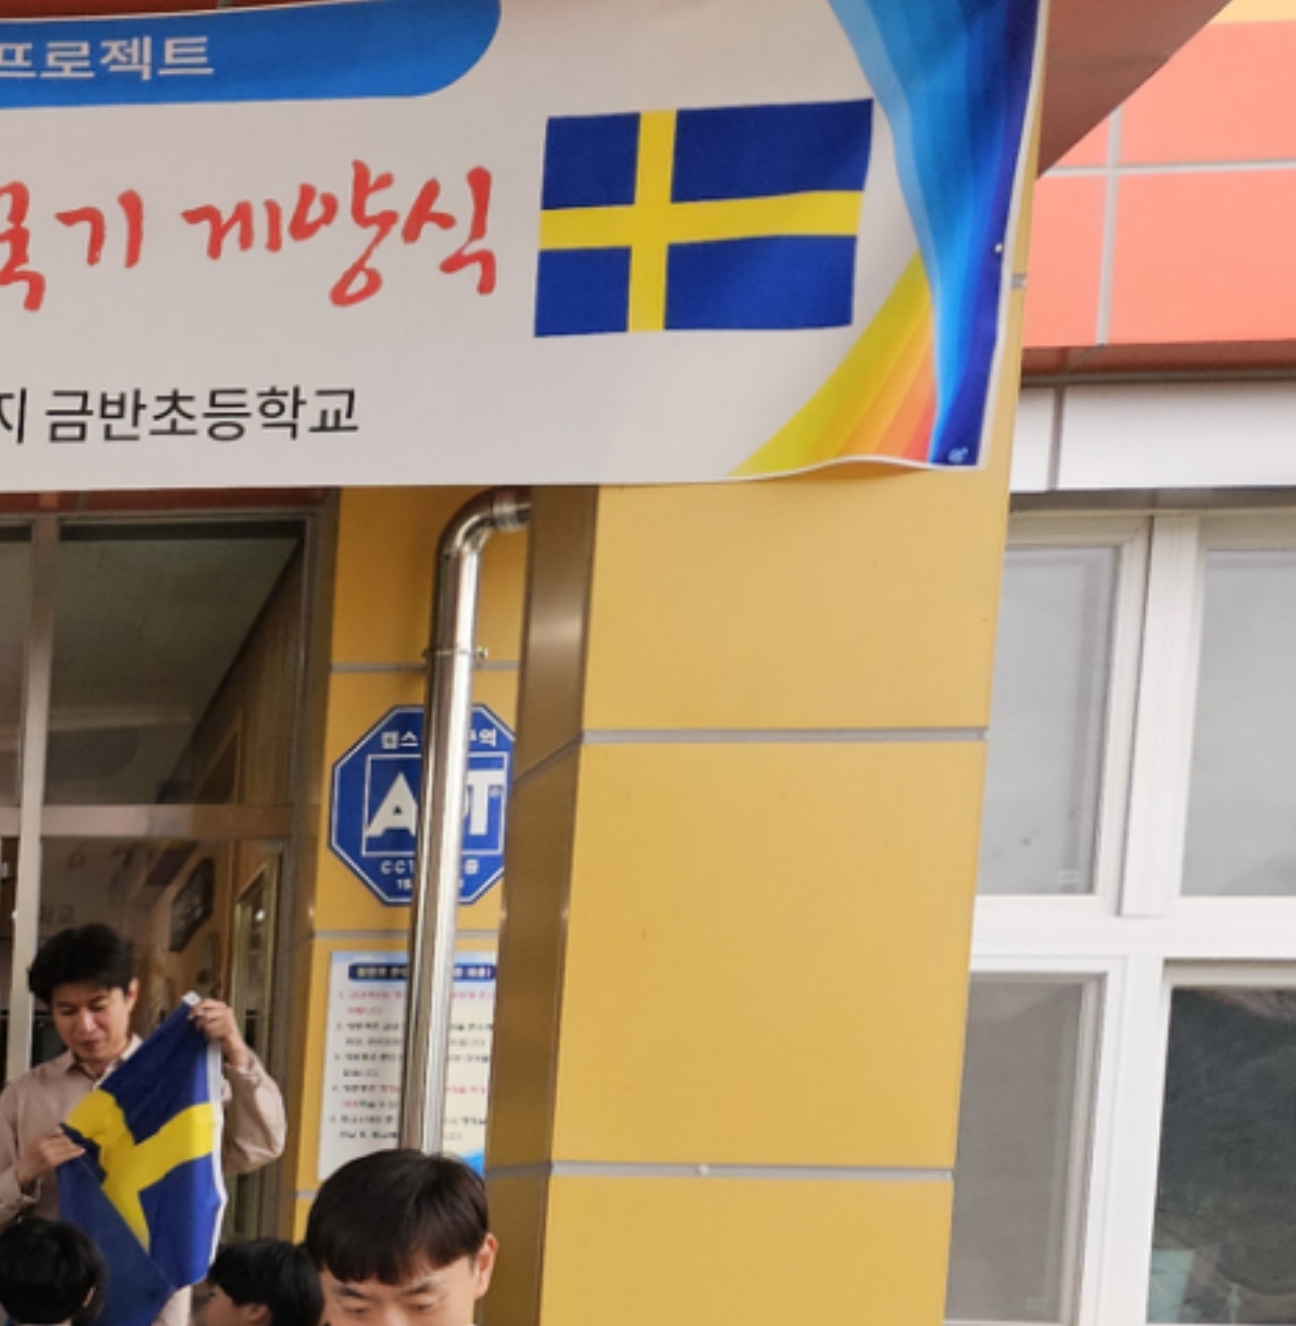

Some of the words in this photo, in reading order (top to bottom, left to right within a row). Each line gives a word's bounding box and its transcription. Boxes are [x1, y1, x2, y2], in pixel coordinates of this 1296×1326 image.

[180, 159, 497, 308] 게양식
[44, 384, 360, 443] 금반초등학교
[365, 769, 505, 838] AT
